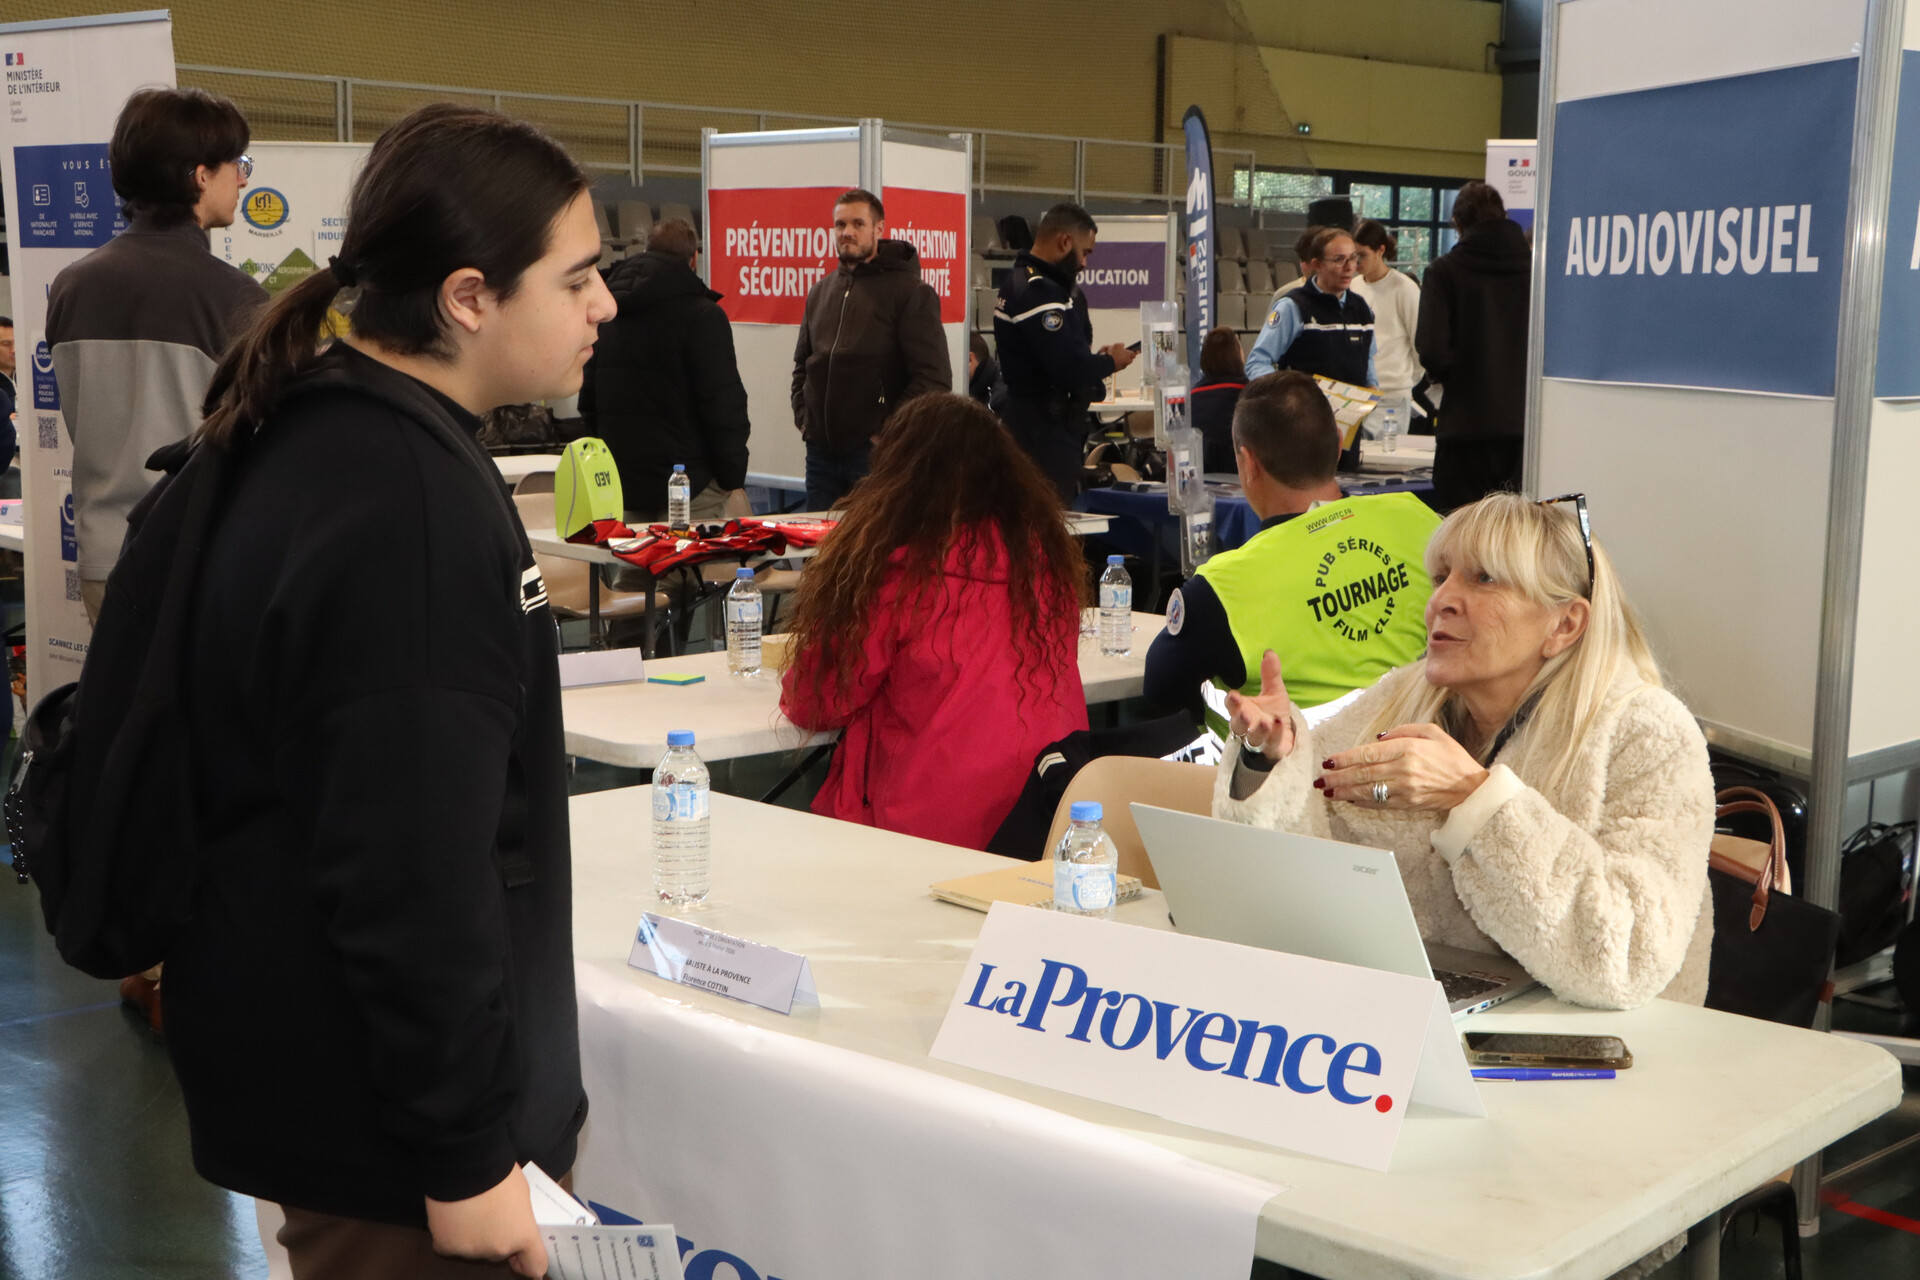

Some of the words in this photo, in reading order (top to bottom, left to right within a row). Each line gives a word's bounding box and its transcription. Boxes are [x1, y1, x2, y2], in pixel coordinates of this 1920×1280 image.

[6, 68, 43, 82] MINISTÈRE
[7, 85, 17, 95] DE
[18, 81, 61, 94] L'INTÉRIEUR
[62, 160, 90, 170] VOUS
[100, 158, 111, 169] ÊT
[1508, 169, 1536, 177] GOUVE
[321, 217, 350, 227] SECTE
[248, 228, 283, 238] MARSEILLE
[317, 231, 346, 241] INDUS
[1565, 204, 1819, 277] AUDIOVISUEL
[238, 262, 275, 274] MENTIONS
[1076, 269, 1149, 285] DUCATION
[595, 471, 611, 488] AED
[1306, 508, 1352, 531] WWW.GITC.FR
[1315, 552, 1336, 588] PUB
[1337, 536, 1391, 566] SÉRIES
[1307, 563, 1409, 622] TOURNAGE
[1333, 618, 1368, 642] FILM
[1374, 596, 1396, 634] CLIP
[48, 637, 73, 650] SCANNEZ
[707, 964, 712, 973] À
[712, 967, 720, 975] LA
[720, 969, 752, 985] PROVENCE
[683, 973, 707, 986] Florence
[707, 981, 729, 993] COTTIN
